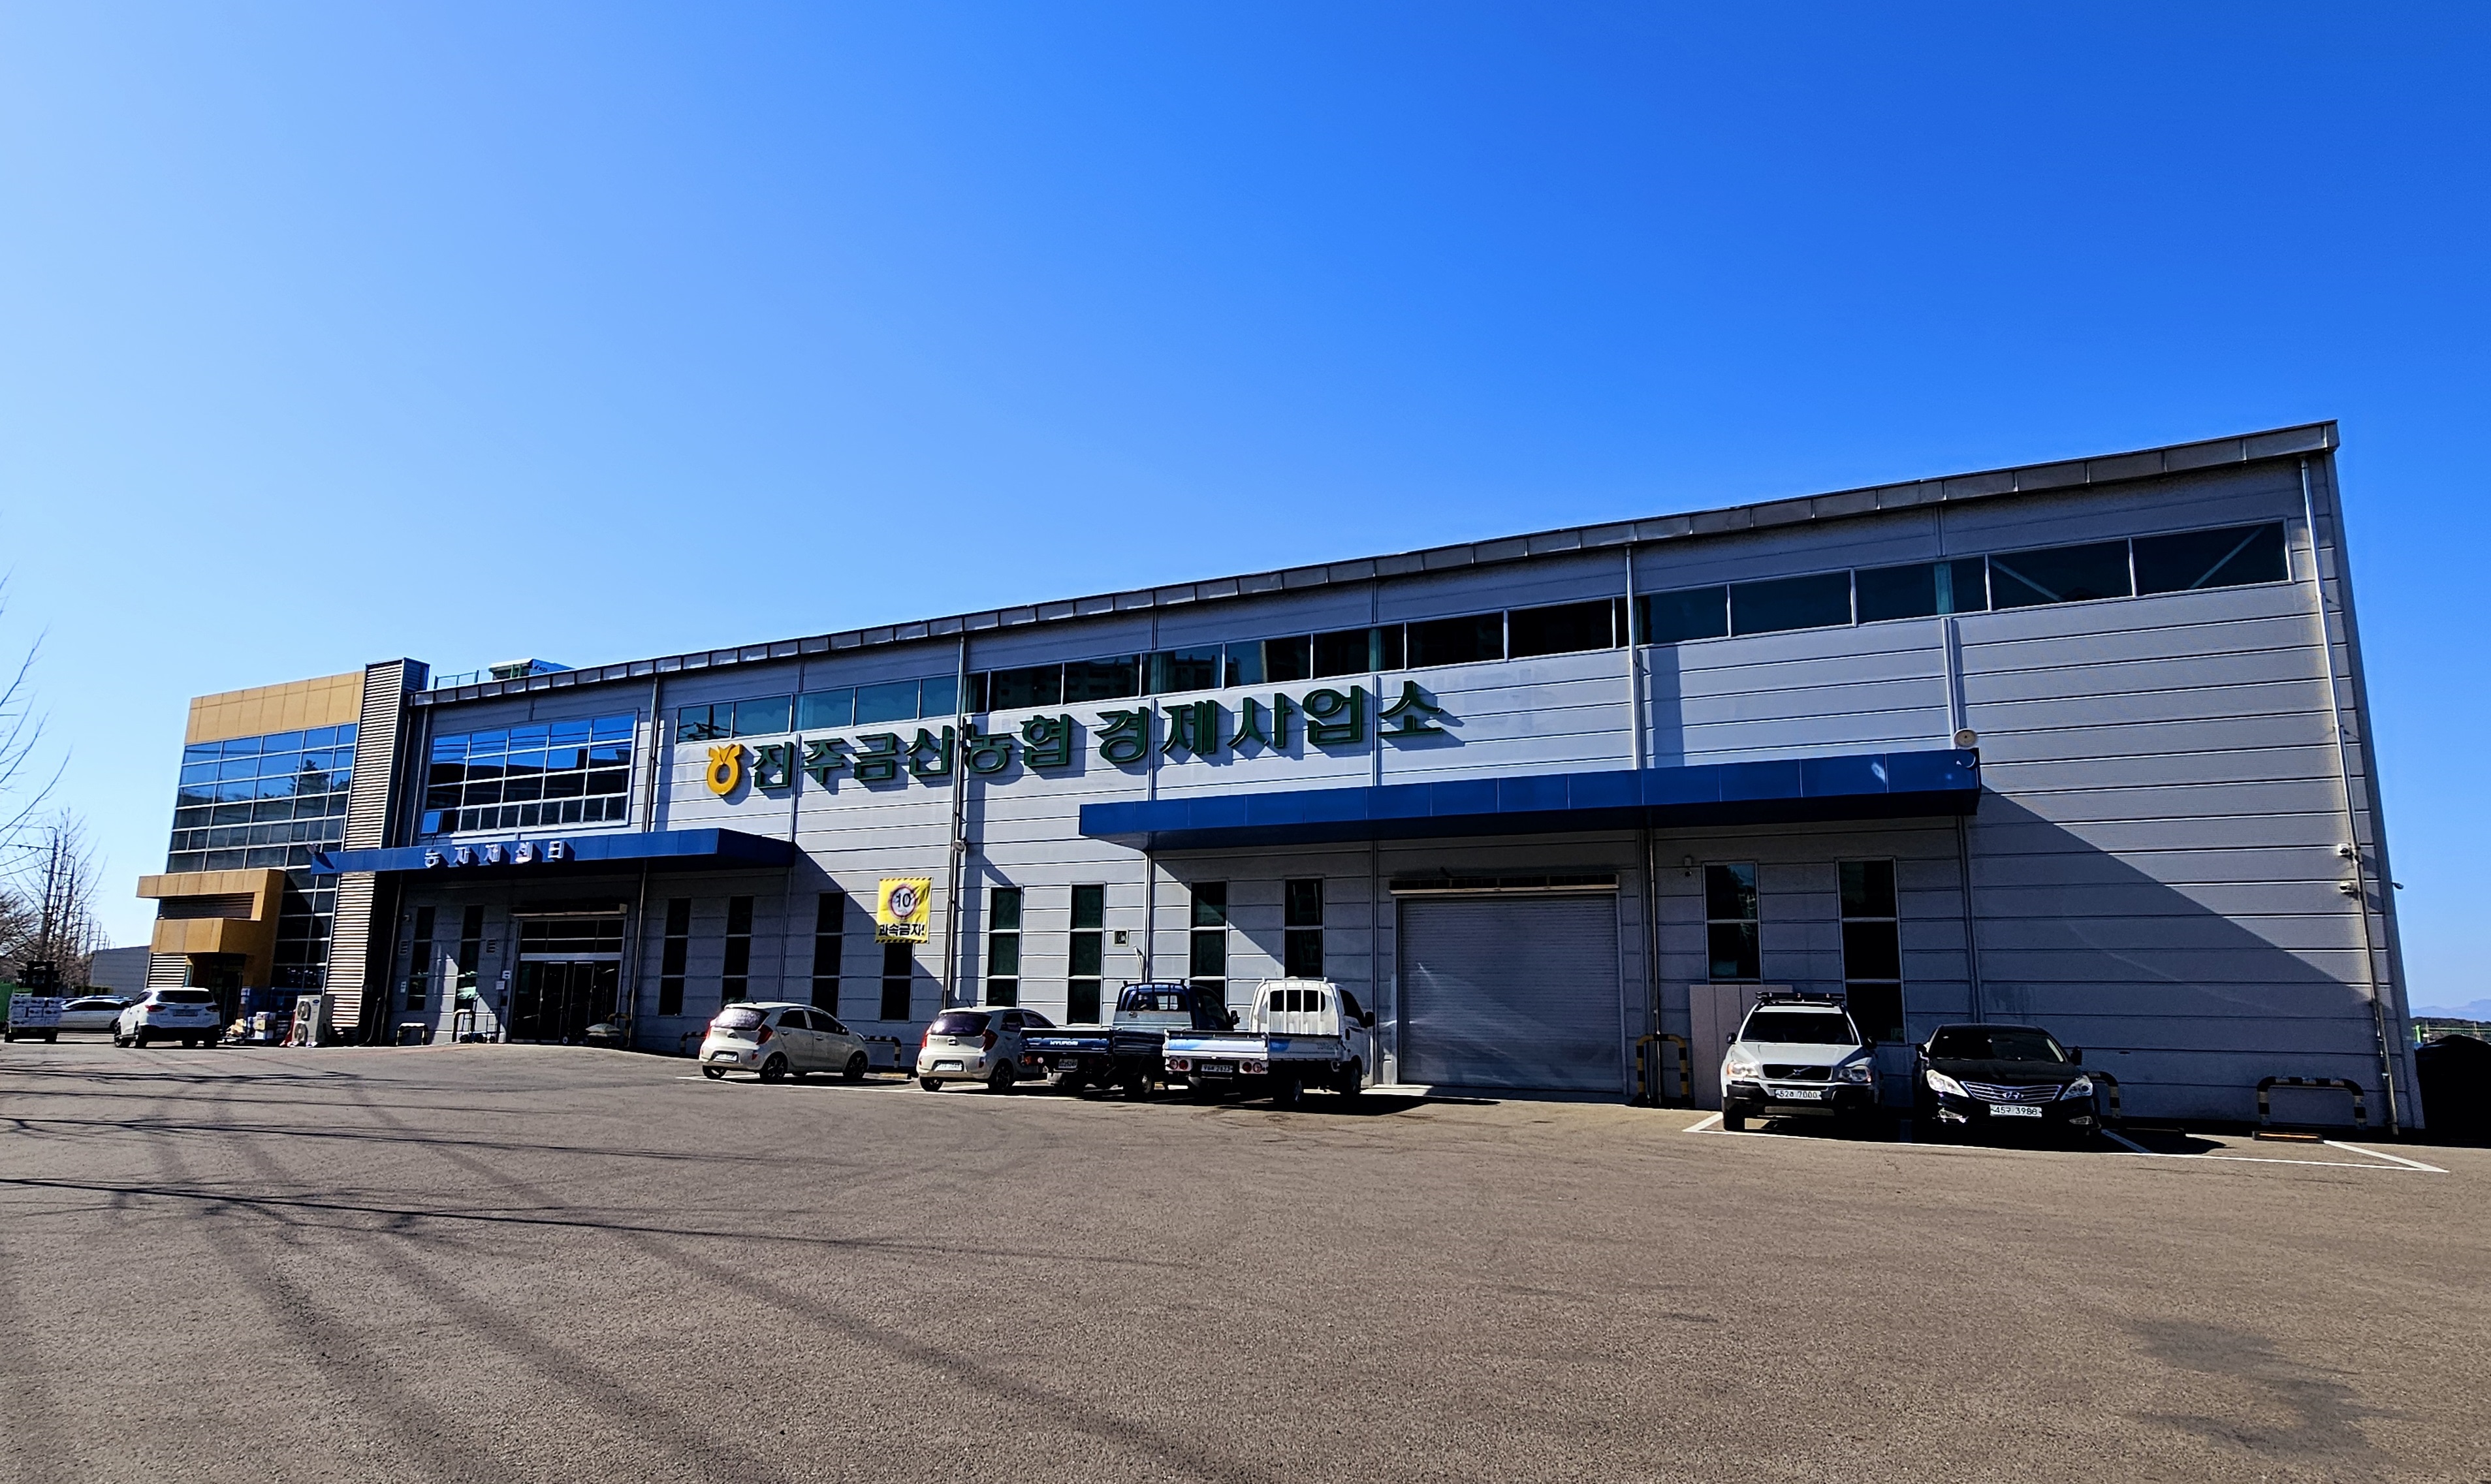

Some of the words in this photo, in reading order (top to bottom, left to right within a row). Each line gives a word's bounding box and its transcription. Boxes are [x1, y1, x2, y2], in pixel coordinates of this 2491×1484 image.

[752, 712, 1071, 789] 진주금산농협
[1094, 680, 1443, 763] 경제사업소
[424, 840, 565, 868] 농자재센터
[896, 892, 912, 908] 10
[878, 923, 925, 936] 과속금지!
